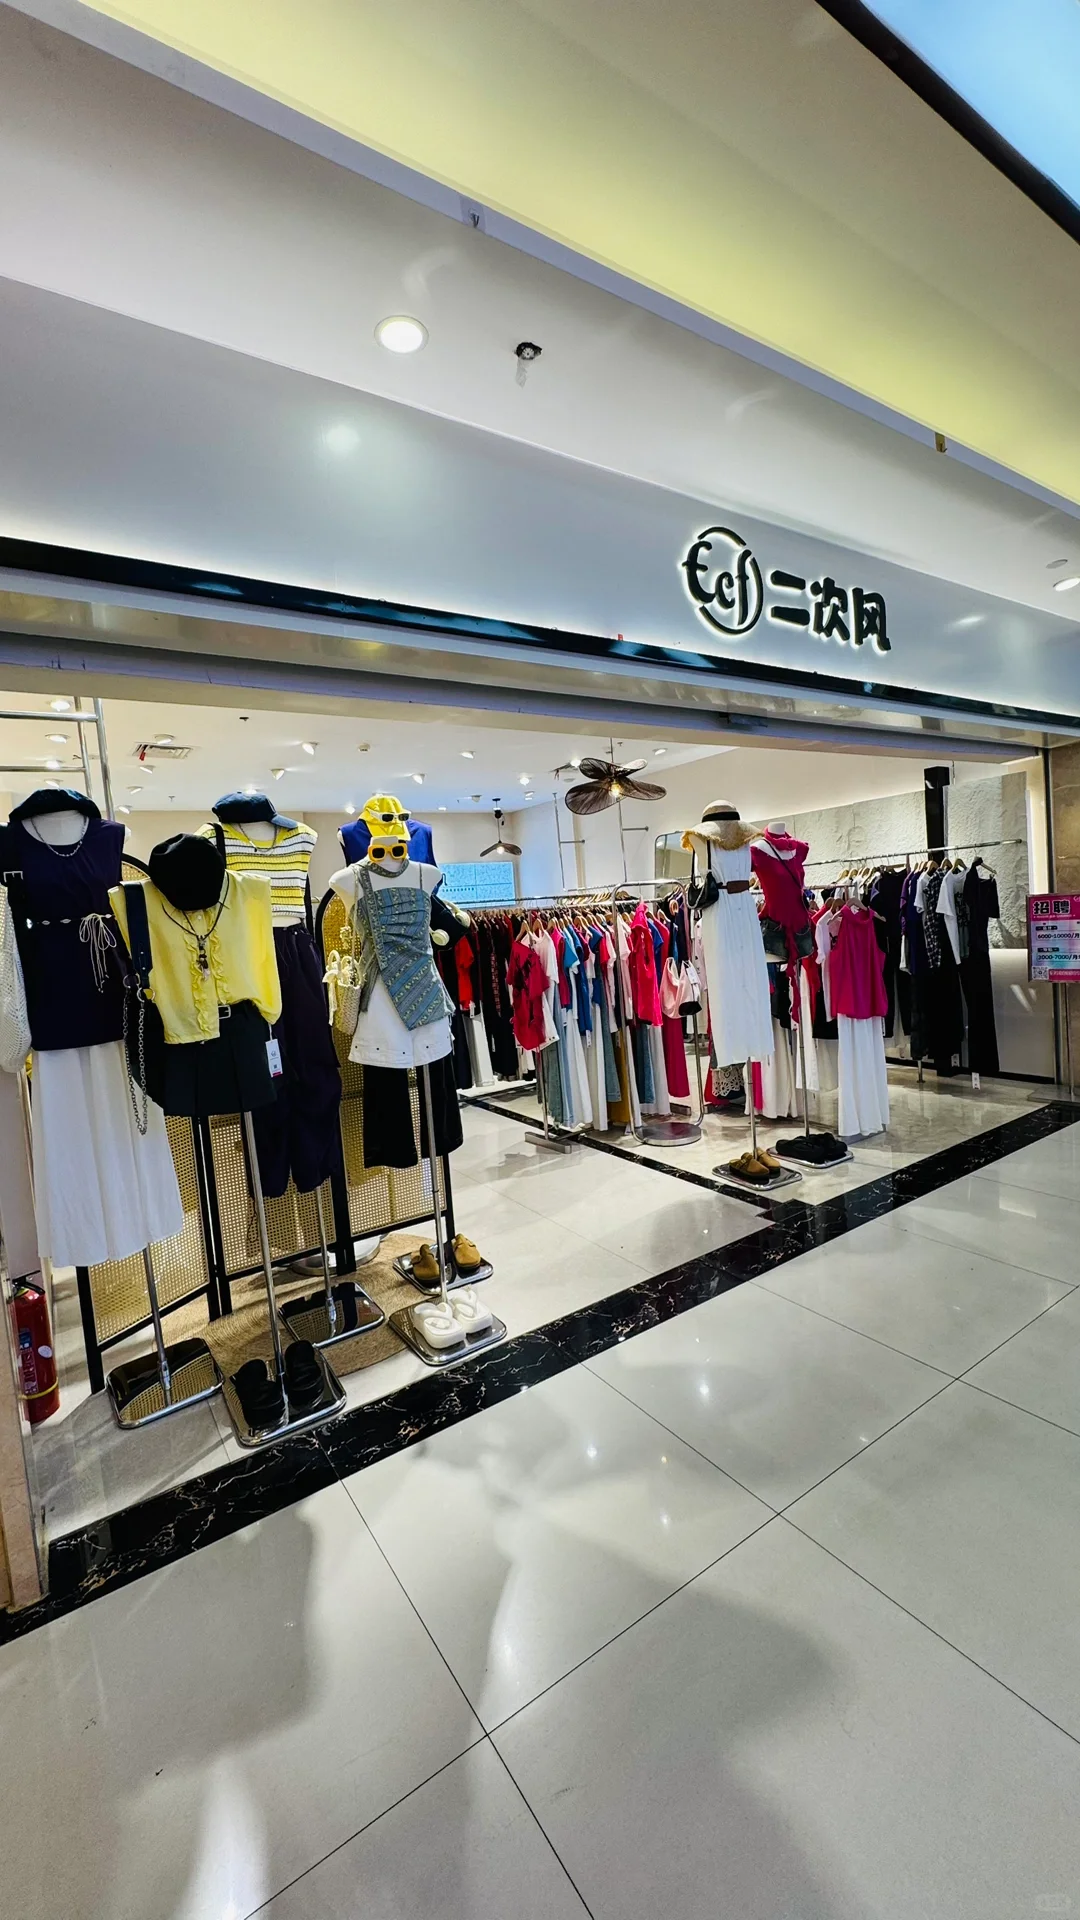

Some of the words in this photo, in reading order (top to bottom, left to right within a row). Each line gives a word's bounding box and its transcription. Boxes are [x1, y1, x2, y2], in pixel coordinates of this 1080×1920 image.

[770, 569, 892, 651] 二次风
[1033, 900, 1070, 915] 招聘
